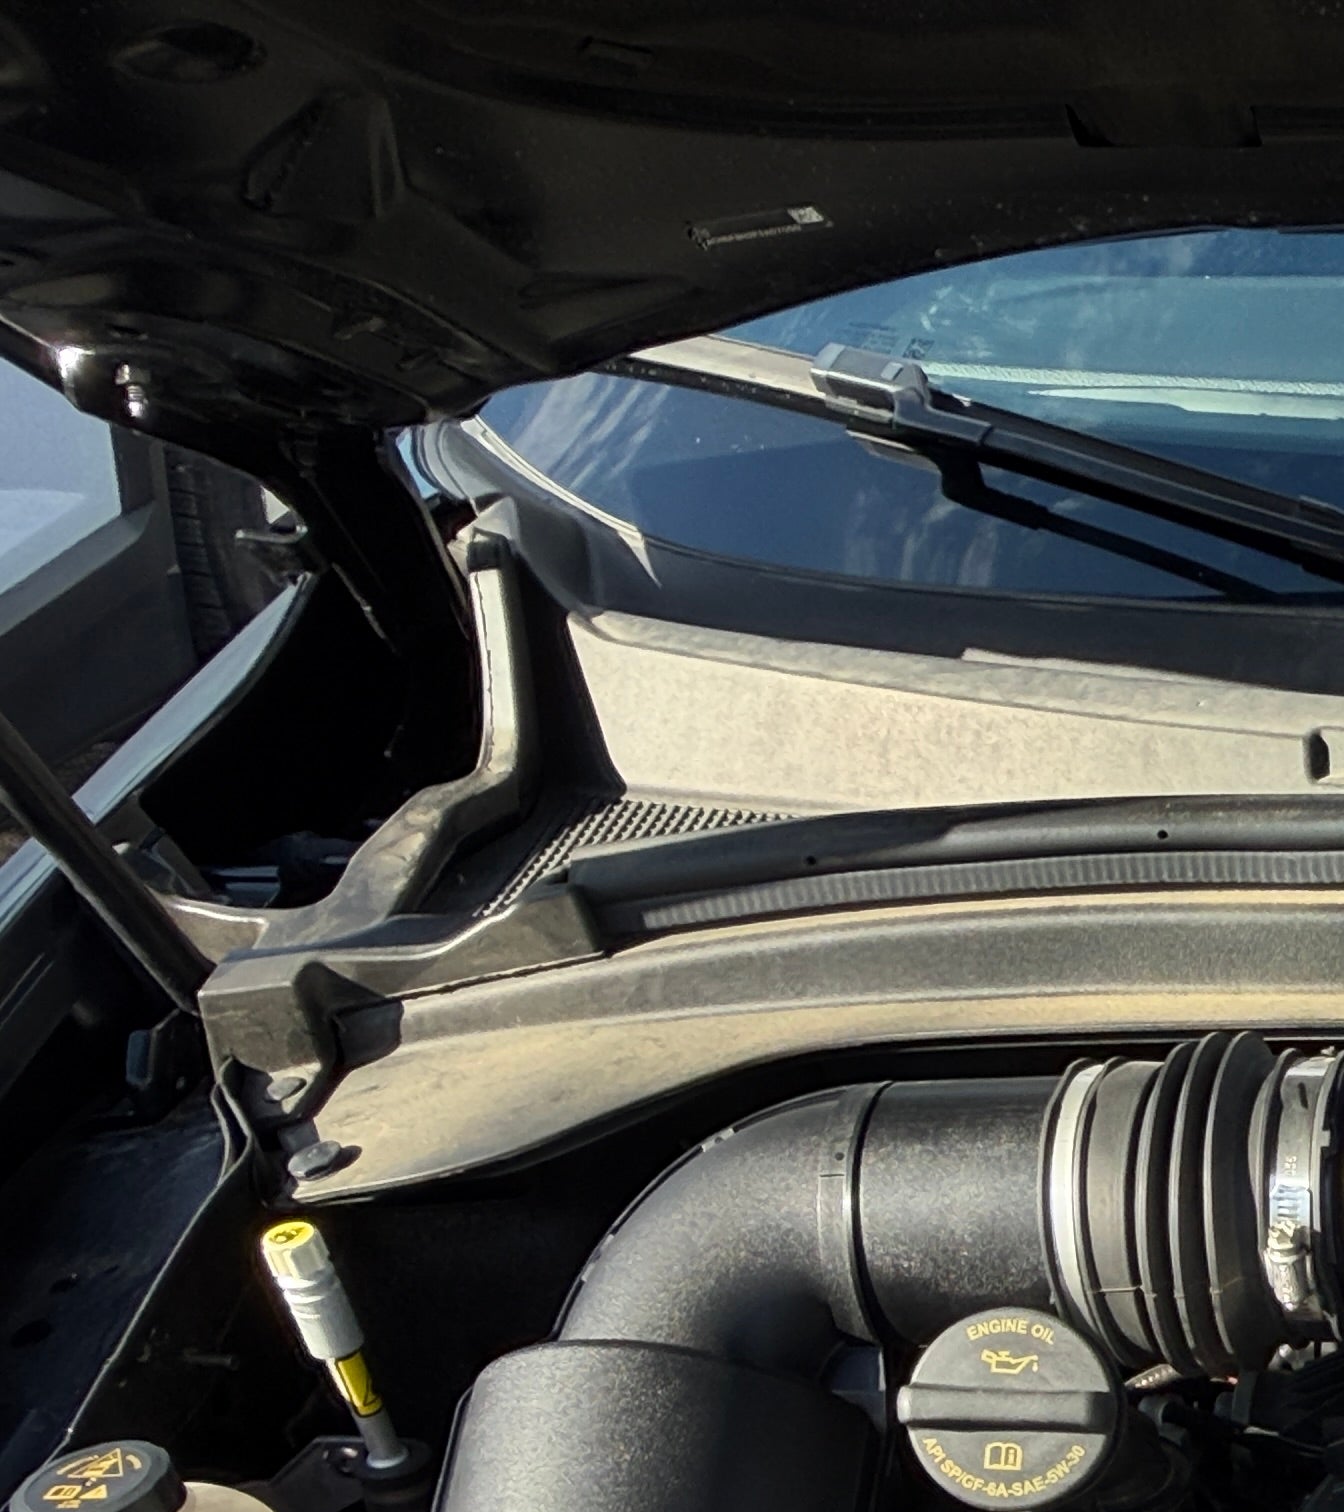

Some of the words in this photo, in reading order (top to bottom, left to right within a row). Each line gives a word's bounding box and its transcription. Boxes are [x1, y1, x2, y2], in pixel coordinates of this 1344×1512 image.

[966, 1318, 1028, 1342] ENGINE
[1031, 1323, 1056, 1346] OIL
[922, 1436, 945, 1463] API
